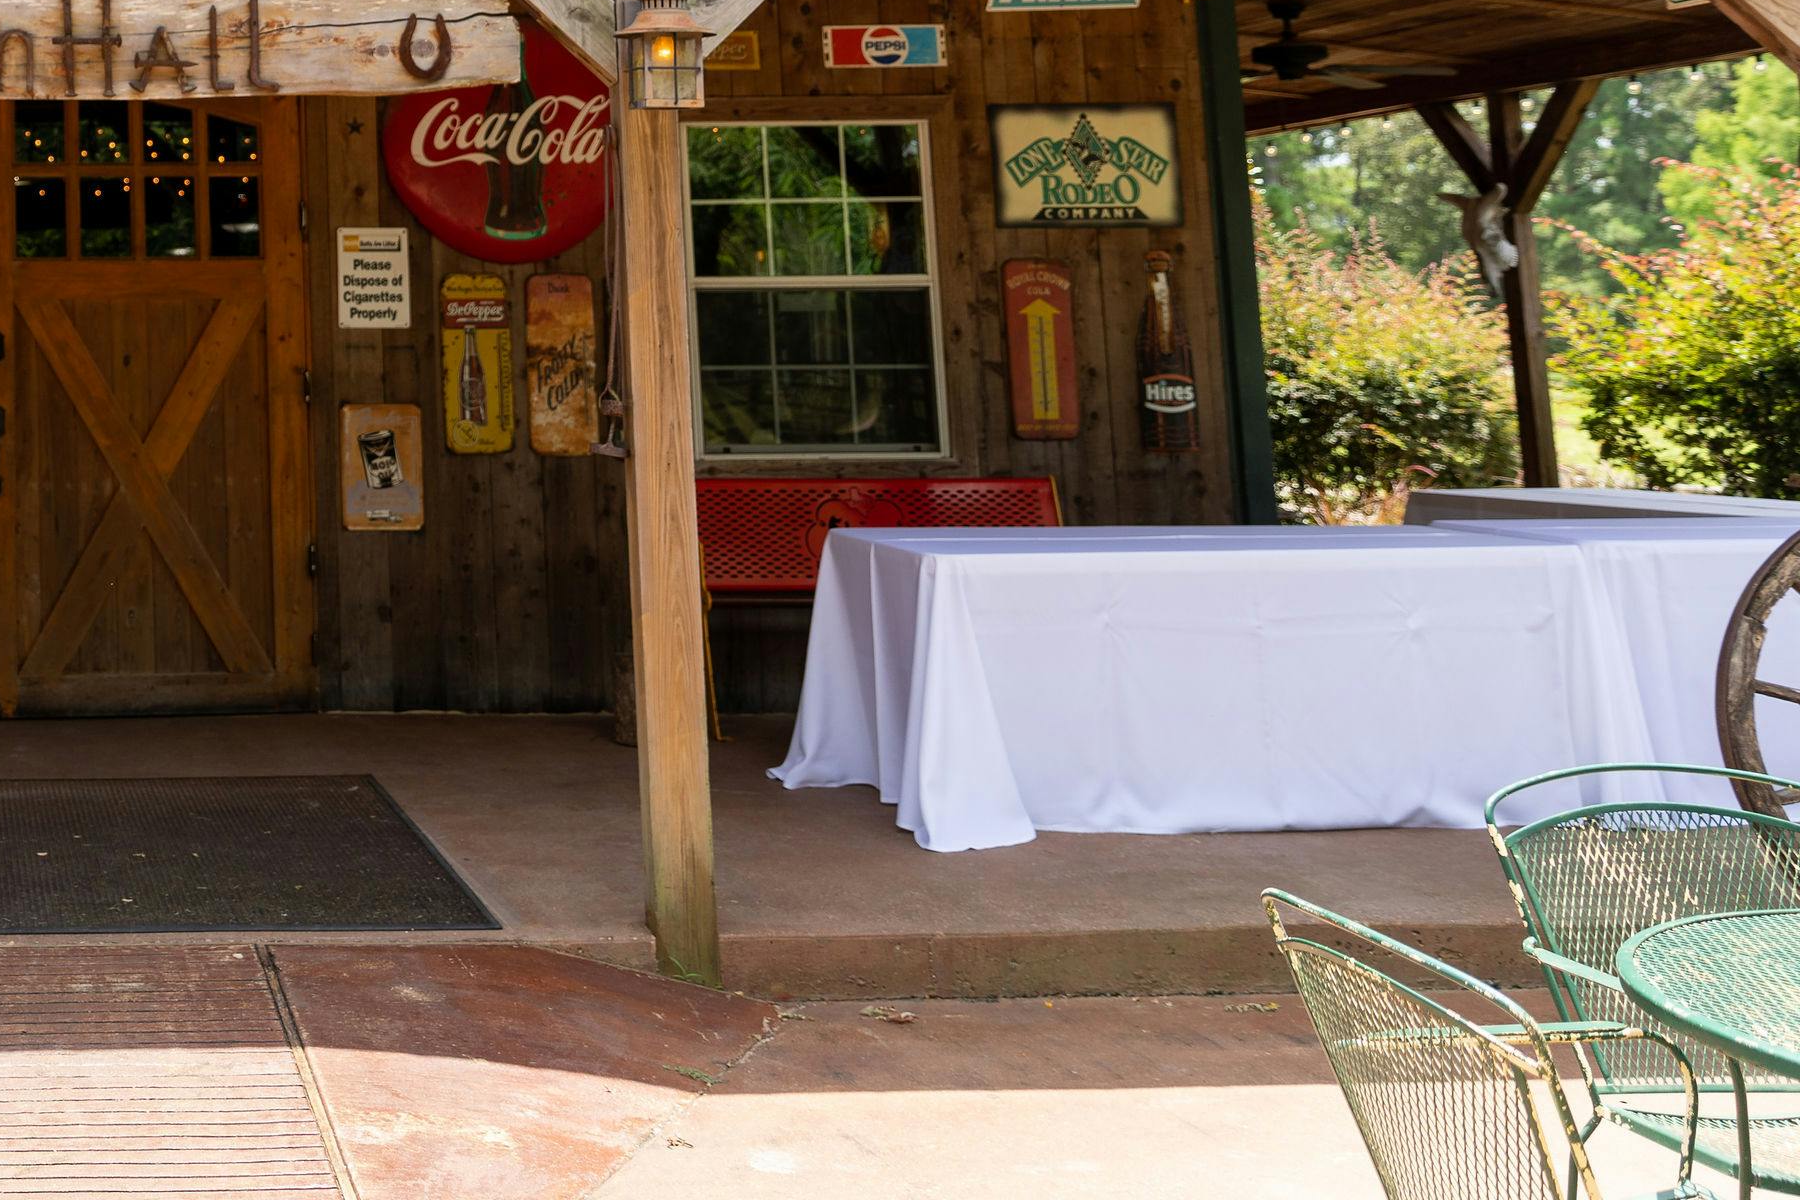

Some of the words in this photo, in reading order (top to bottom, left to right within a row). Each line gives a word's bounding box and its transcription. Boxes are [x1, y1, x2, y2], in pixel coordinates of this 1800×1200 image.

[865, 40, 906, 51] PEPSI
[409, 94, 610, 167] Coca-Cola
[1009, 139, 1063, 182] LONE
[1117, 139, 1163, 183] STAR
[1041, 172, 1141, 205] RODEO
[1044, 207, 1137, 220] COMPANY
[353, 259, 392, 271] Please
[343, 275, 388, 289] Dispose
[391, 274, 403, 287] of
[343, 290, 404, 305] Cigarettes
[350, 307, 398, 320] Properly
[1145, 379, 1196, 401] Hires
